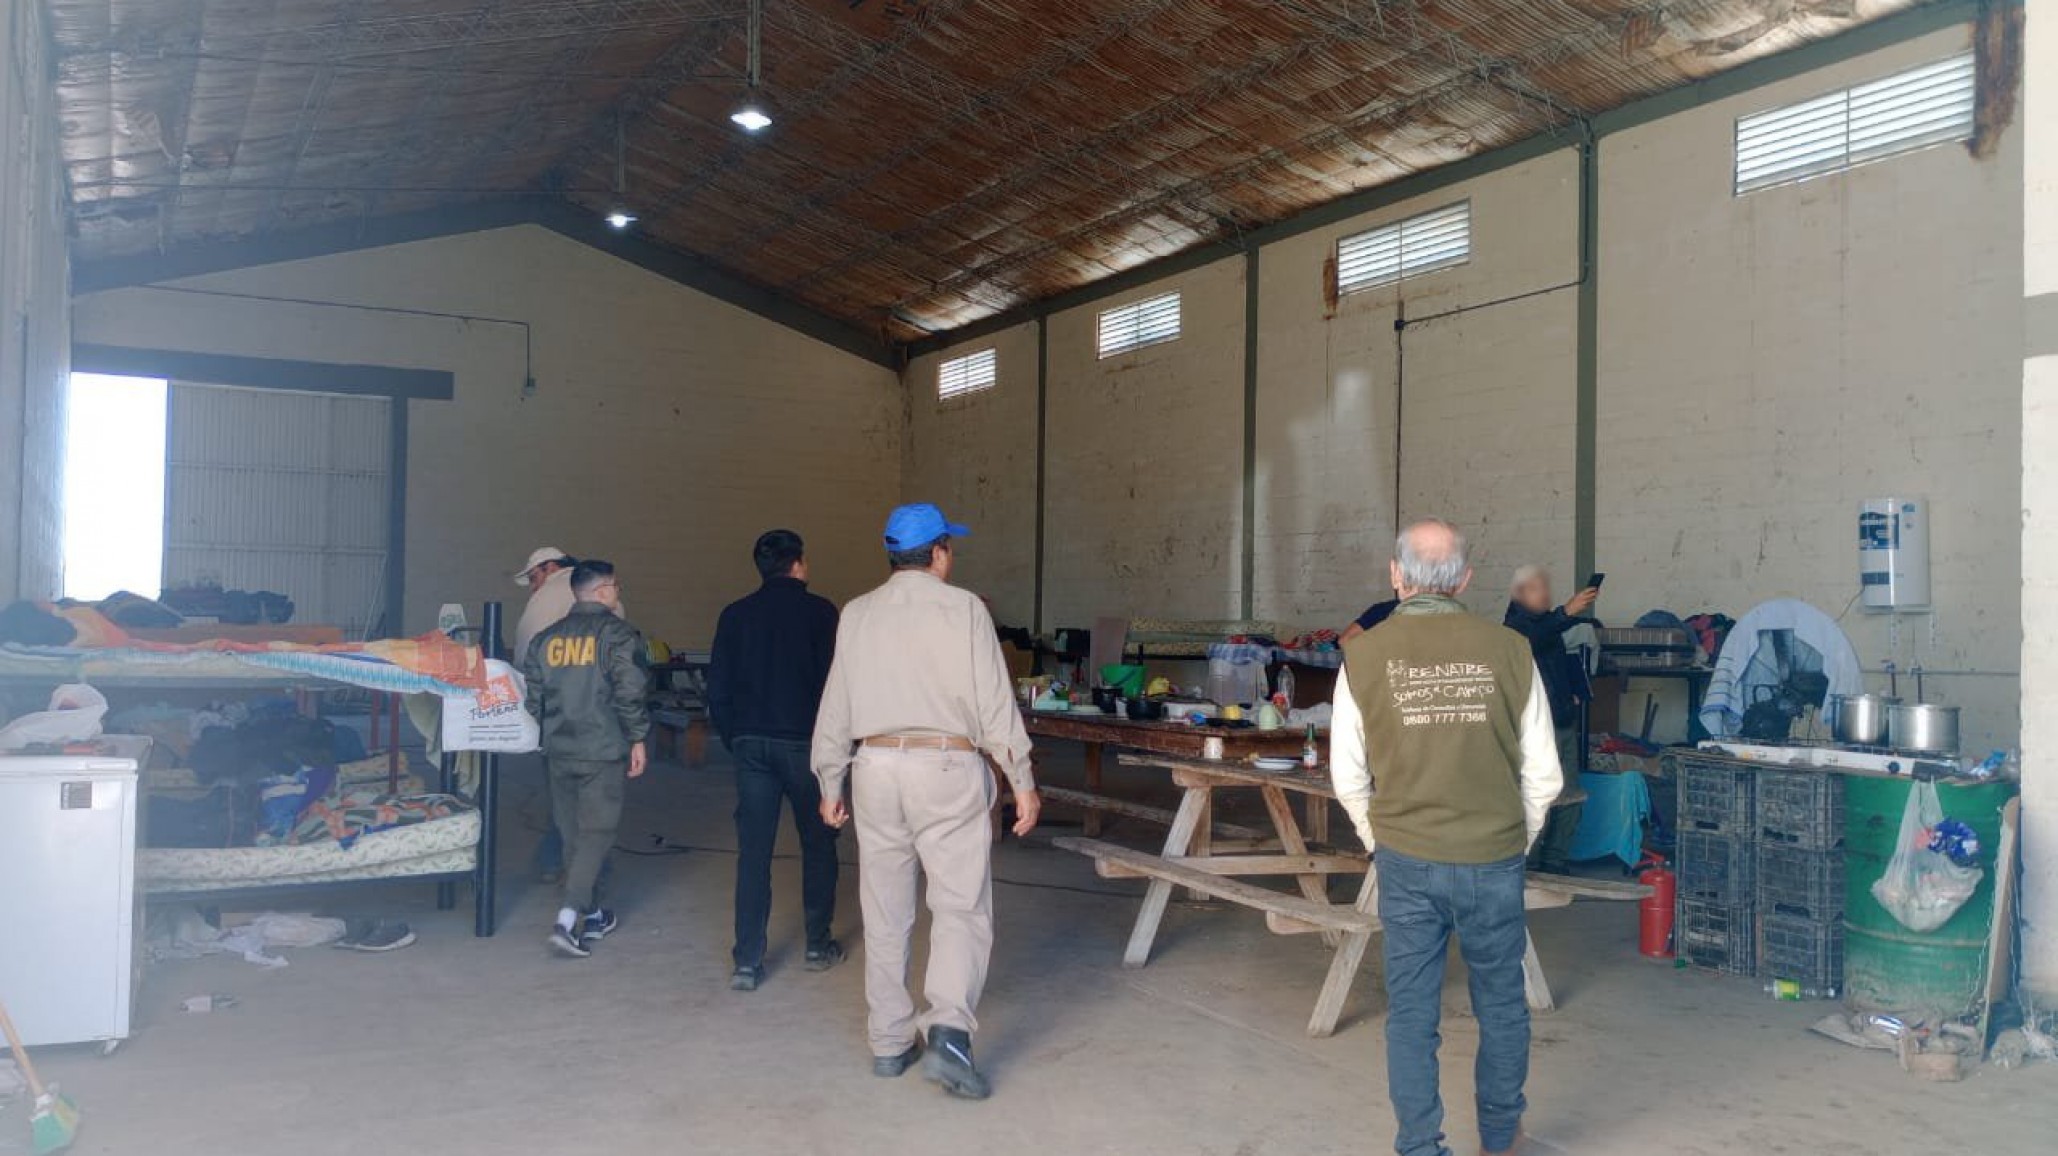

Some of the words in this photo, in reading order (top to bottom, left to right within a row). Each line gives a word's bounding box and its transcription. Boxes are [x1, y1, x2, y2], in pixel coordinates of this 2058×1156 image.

[548, 636, 596, 666] GNA
[1409, 663, 1492, 678] RENATRE
[1403, 714, 1430, 726] 0800
[1432, 712, 1456, 724] 777
